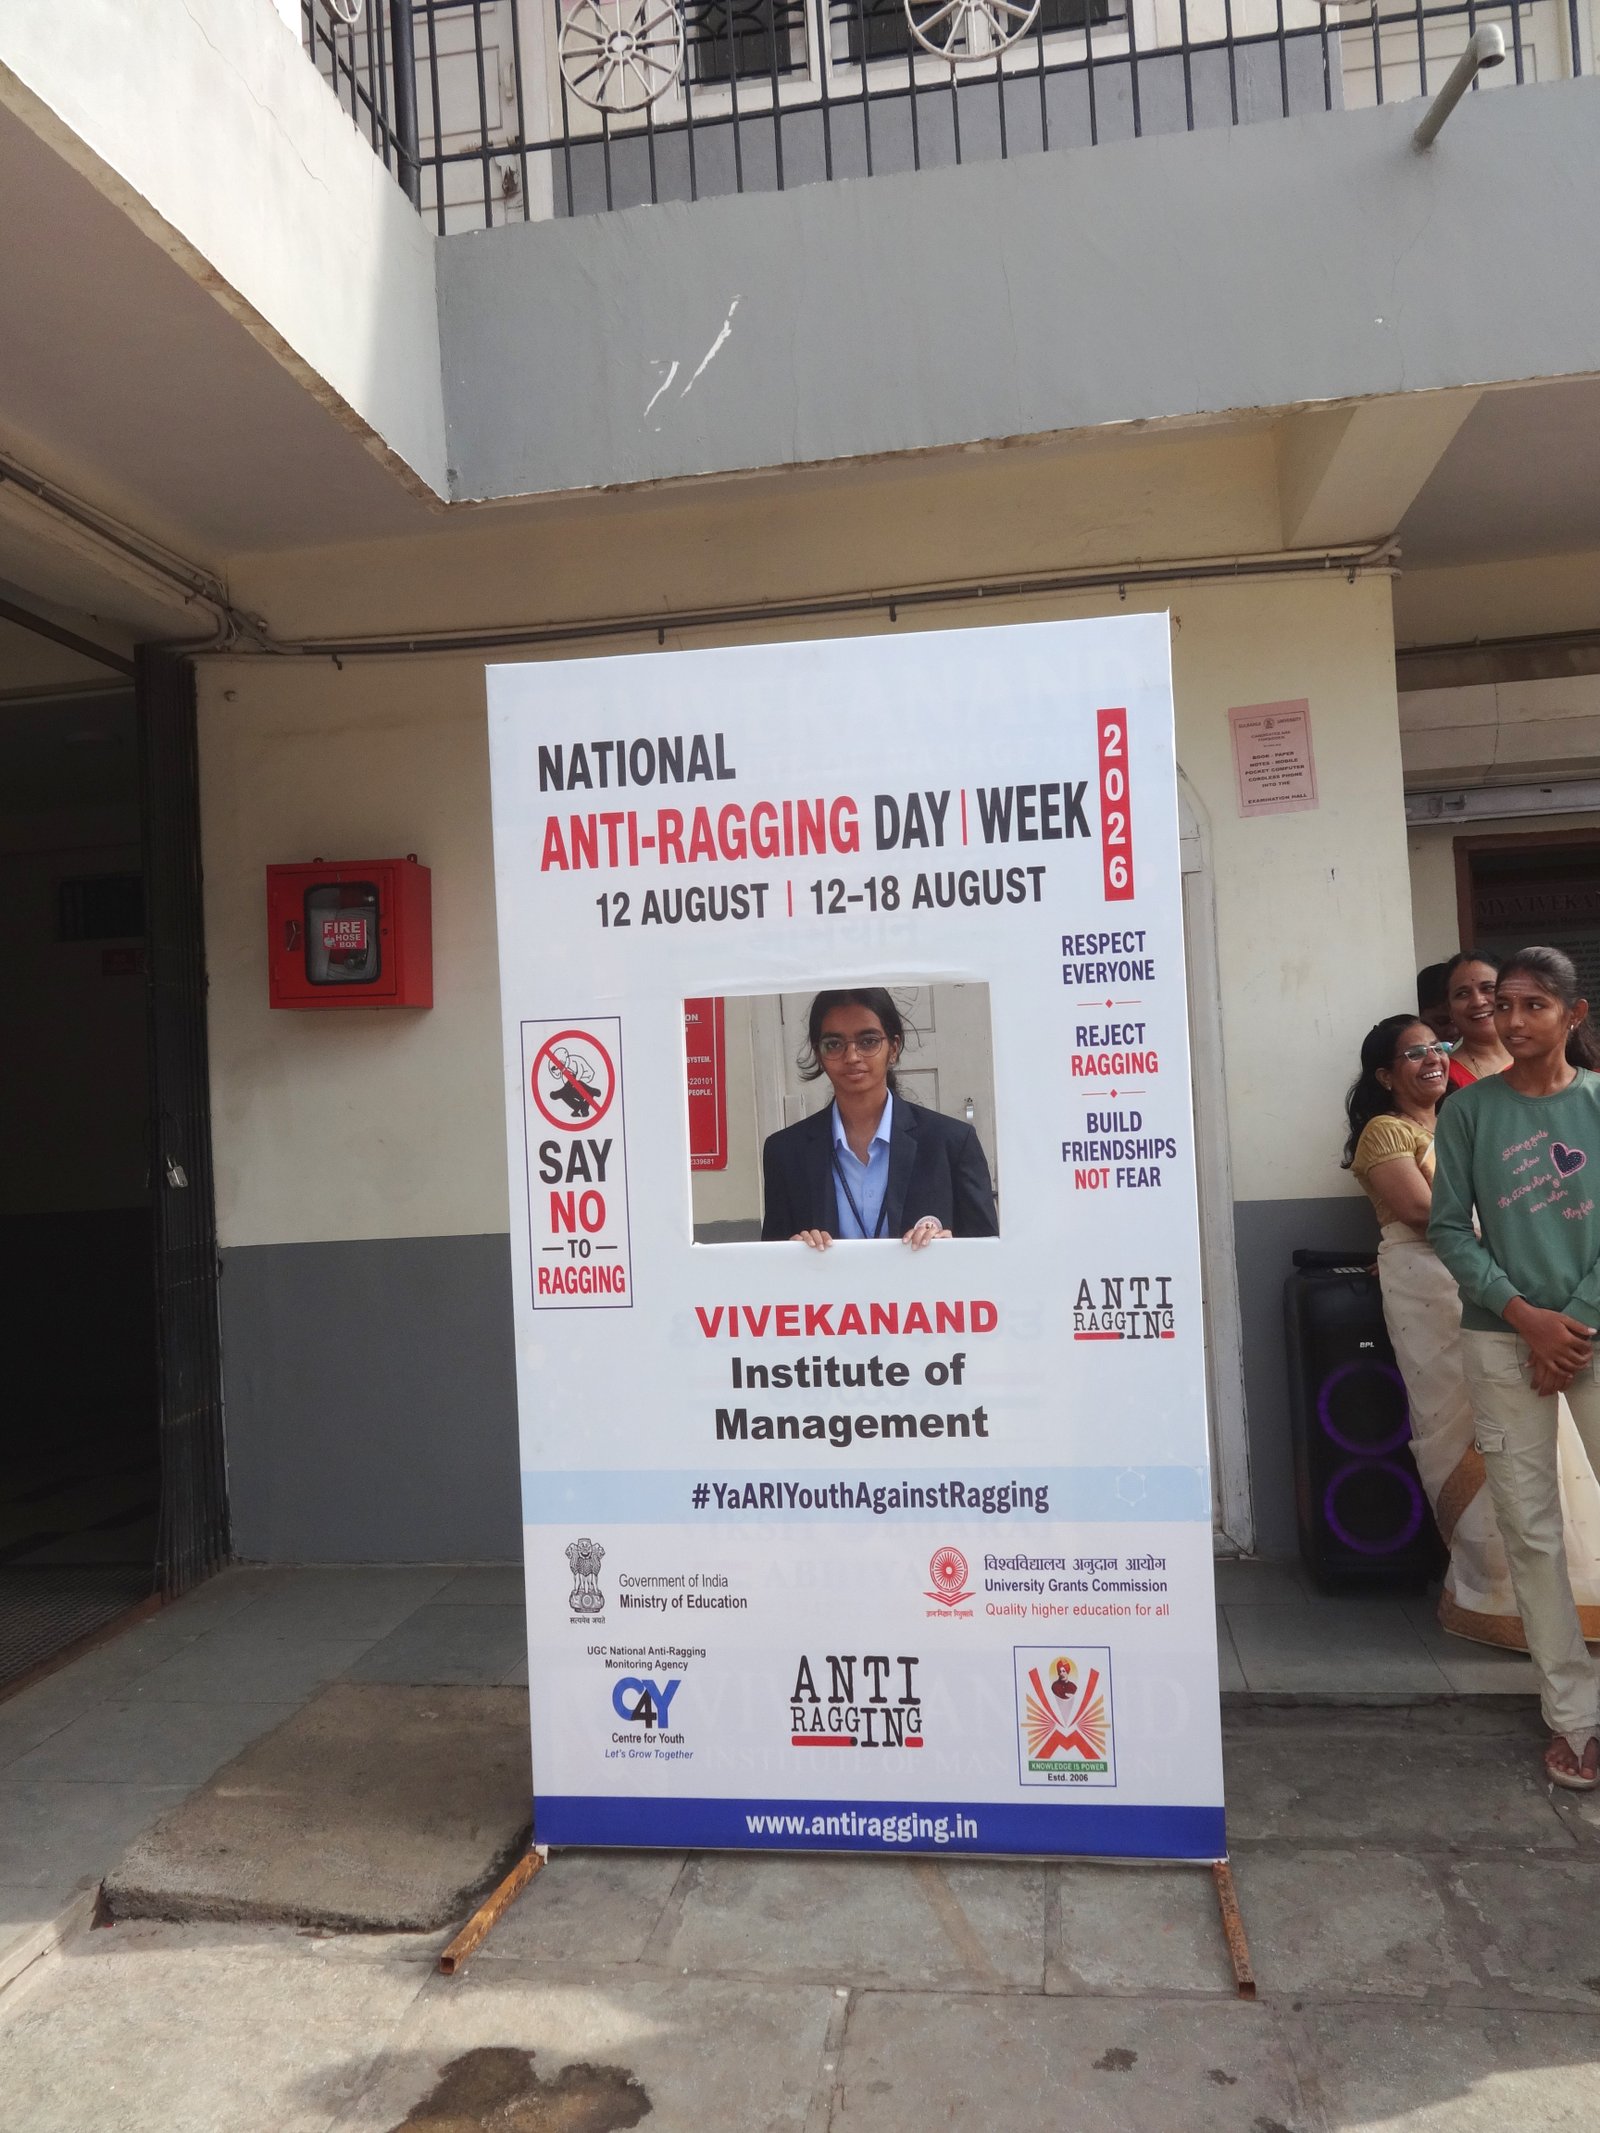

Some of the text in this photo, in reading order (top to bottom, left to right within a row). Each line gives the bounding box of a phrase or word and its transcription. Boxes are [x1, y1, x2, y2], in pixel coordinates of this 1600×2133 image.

[538, 732, 737, 793] NATIONAL
[1102, 724, 1129, 888] 2026
[540, 780, 1092, 873] ANTI-RAGGING DAY WEEK
[595, 891, 631, 928] 12
[640, 881, 770, 927] AUGUST
[910, 865, 1047, 911] AUGUST
[324, 921, 361, 934] FIRE
[339, 941, 357, 949] BOX
[1061, 930, 1147, 957] RESPECT
[1062, 959, 1156, 985] EVERYONE
[1075, 1022, 1146, 1047] REJECT
[1071, 1050, 1159, 1077] RAGGING
[688, 1088, 713, 1096] PEOPLE.
[1086, 1110, 1143, 1134] BUILD
[538, 1138, 614, 1185] SAY
[1062, 1137, 1177, 1163] FRIENDSHIPS
[1074, 1166, 1162, 1190] NOT FEAR
[550, 1190, 607, 1234] NO
[567, 1238, 591, 1259] TO
[538, 1264, 626, 1296] RAGGING
[1073, 1276, 1174, 1311] ANTI
[695, 1299, 999, 1339] VIVEKANAND
[1073, 1310, 1175, 1340] RAGGING
[731, 1352, 967, 1390] Institute of
[714, 1404, 990, 1448] Management
[691, 1479, 1050, 1515] #YaARIYouthAgainstRagging
[984, 1553, 1167, 1576] विश्वविद्यालय अनुदान आयोग
[618, 1573, 729, 1588] Government of India
[984, 1578, 1168, 1596] University Grants Commission
[619, 1594, 748, 1611] Ministry of Education
[985, 1602, 1169, 1619] Quality higher education for all
[586, 1646, 707, 1658] UGC National Anti-Ragging
[604, 1659, 689, 1671] Monitoring Agency
[790, 1655, 921, 1705] ANTI
[612, 1676, 681, 1729] C4Y
[611, 1732, 685, 1744] Centre for Youth
[790, 1706, 923, 1749] RAGGING
[604, 1748, 693, 1761] Let's Grow Together
[1031, 1762, 1105, 1771] KNOWLEDGE IS POWER
[1047, 1773, 1089, 1783] Estd. 2006
[745, 1811, 979, 1843] www.antiragging.in
